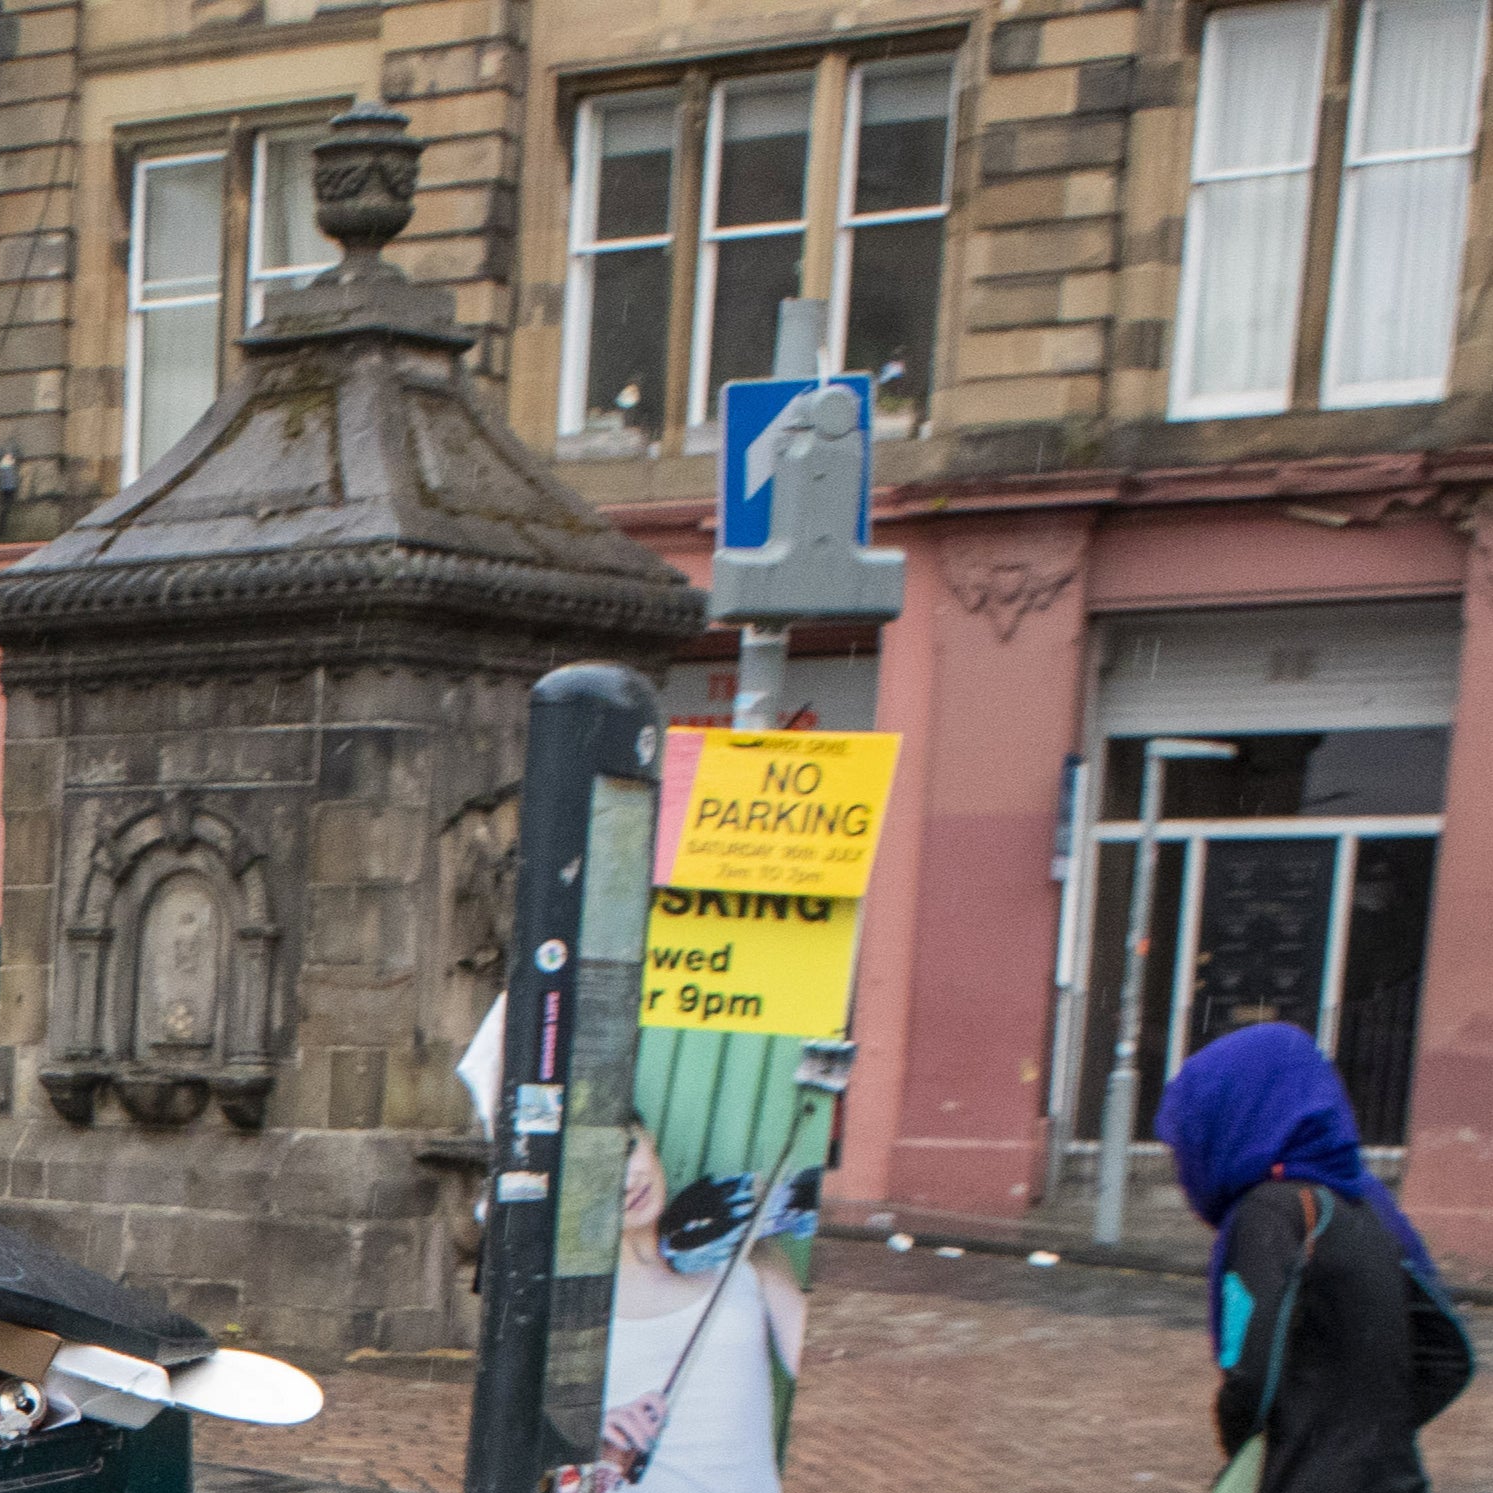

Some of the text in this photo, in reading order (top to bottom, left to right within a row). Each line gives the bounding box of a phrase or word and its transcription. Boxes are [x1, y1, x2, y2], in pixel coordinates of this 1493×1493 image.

[761, 761, 821, 796] NO
[695, 797, 872, 838] PARKING
[678, 982, 764, 1022] 9pm
